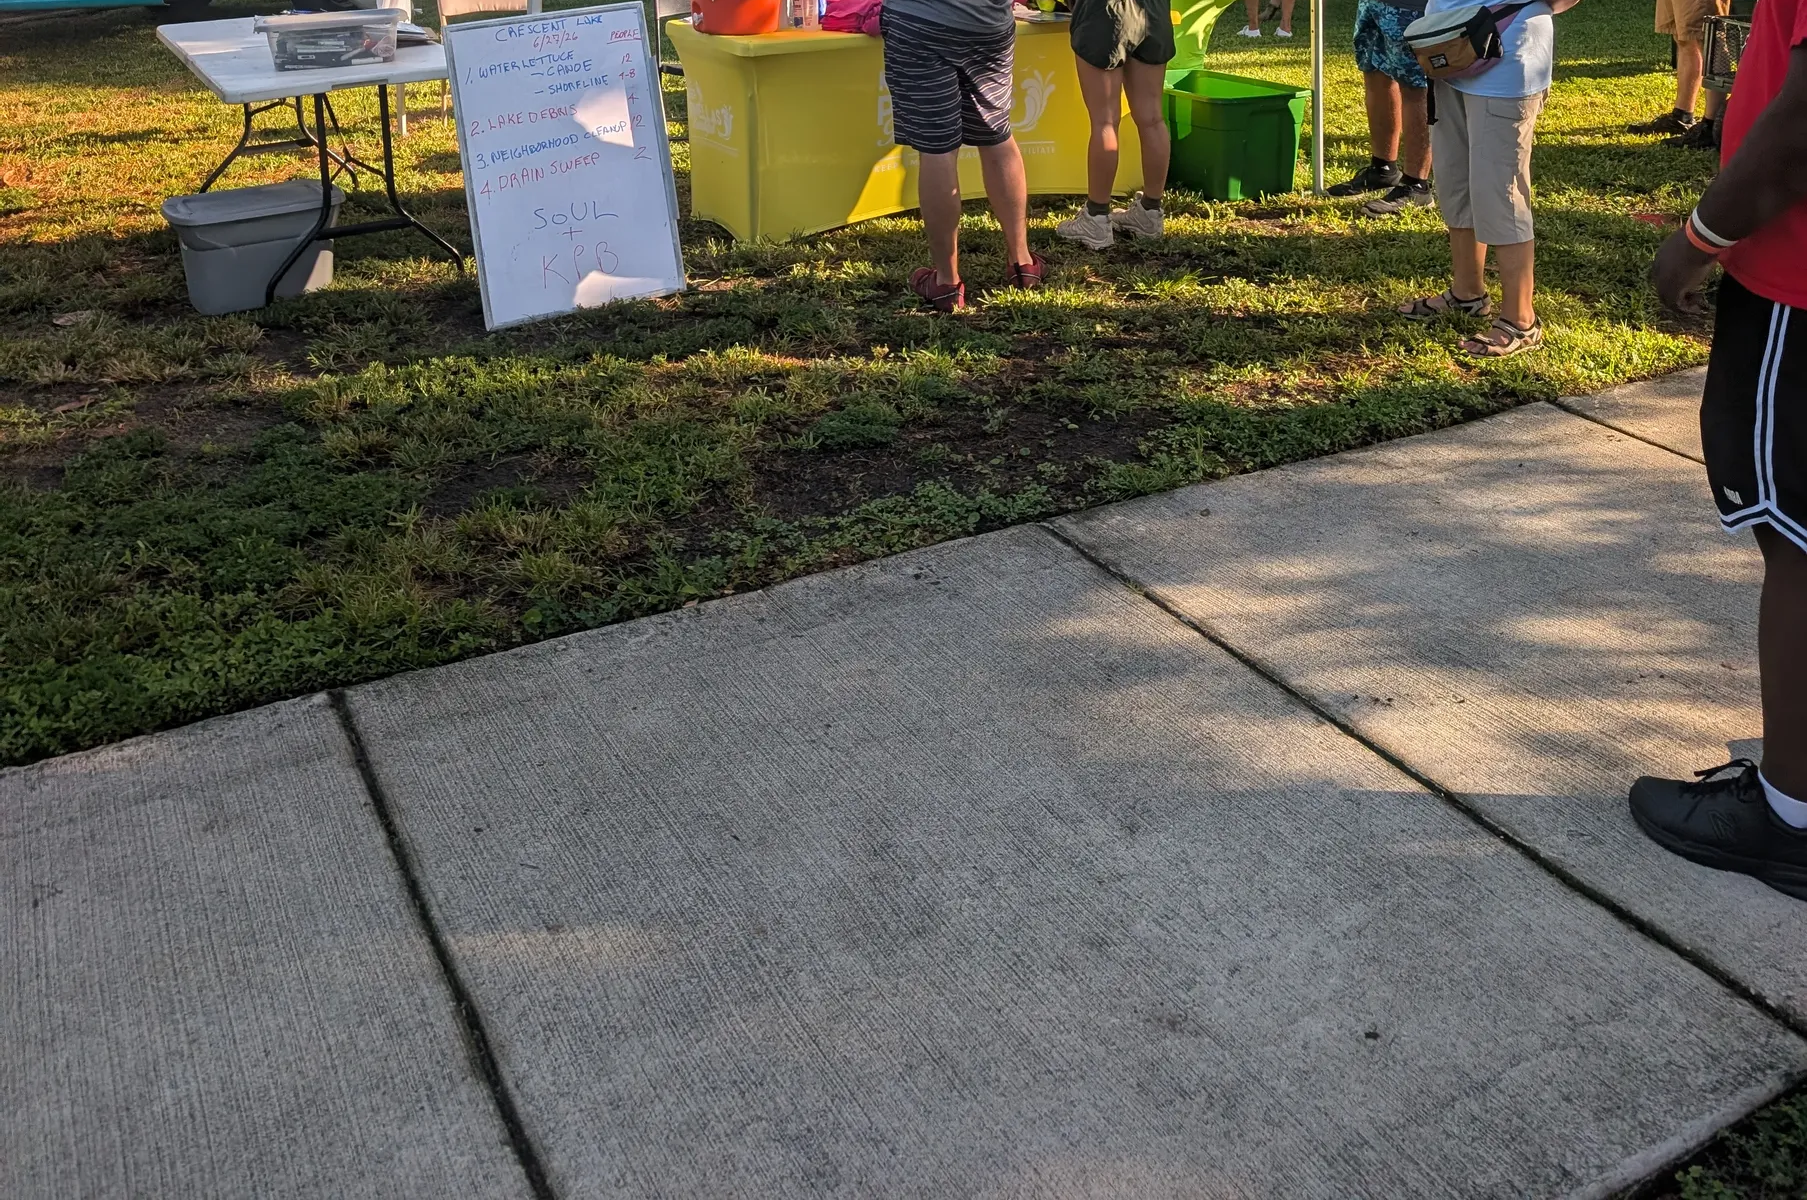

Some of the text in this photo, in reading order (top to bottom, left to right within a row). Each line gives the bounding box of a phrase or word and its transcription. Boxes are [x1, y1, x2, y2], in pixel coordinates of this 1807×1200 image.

[495, 15, 603, 42] CRESCENT LAKE
[610, 28, 639, 40] PEOPLE
[479, 61, 515, 79] WATER
[522, 50, 575, 68] LETTUCE
[546, 59, 593, 77] CANOE
[621, 52, 632, 64] 12
[549, 74, 609, 96] SHORELINE
[628, 92, 639, 105] 4
[470, 104, 578, 137] 2. LAKE DEBRIS
[476, 121, 627, 170] 3. NEIGHBORHOOD CLEANUP
[633, 146, 652, 160] 2
[480, 152, 600, 199] 4. DRAIN SWEEP
[543, 241, 619, 289] KPB
